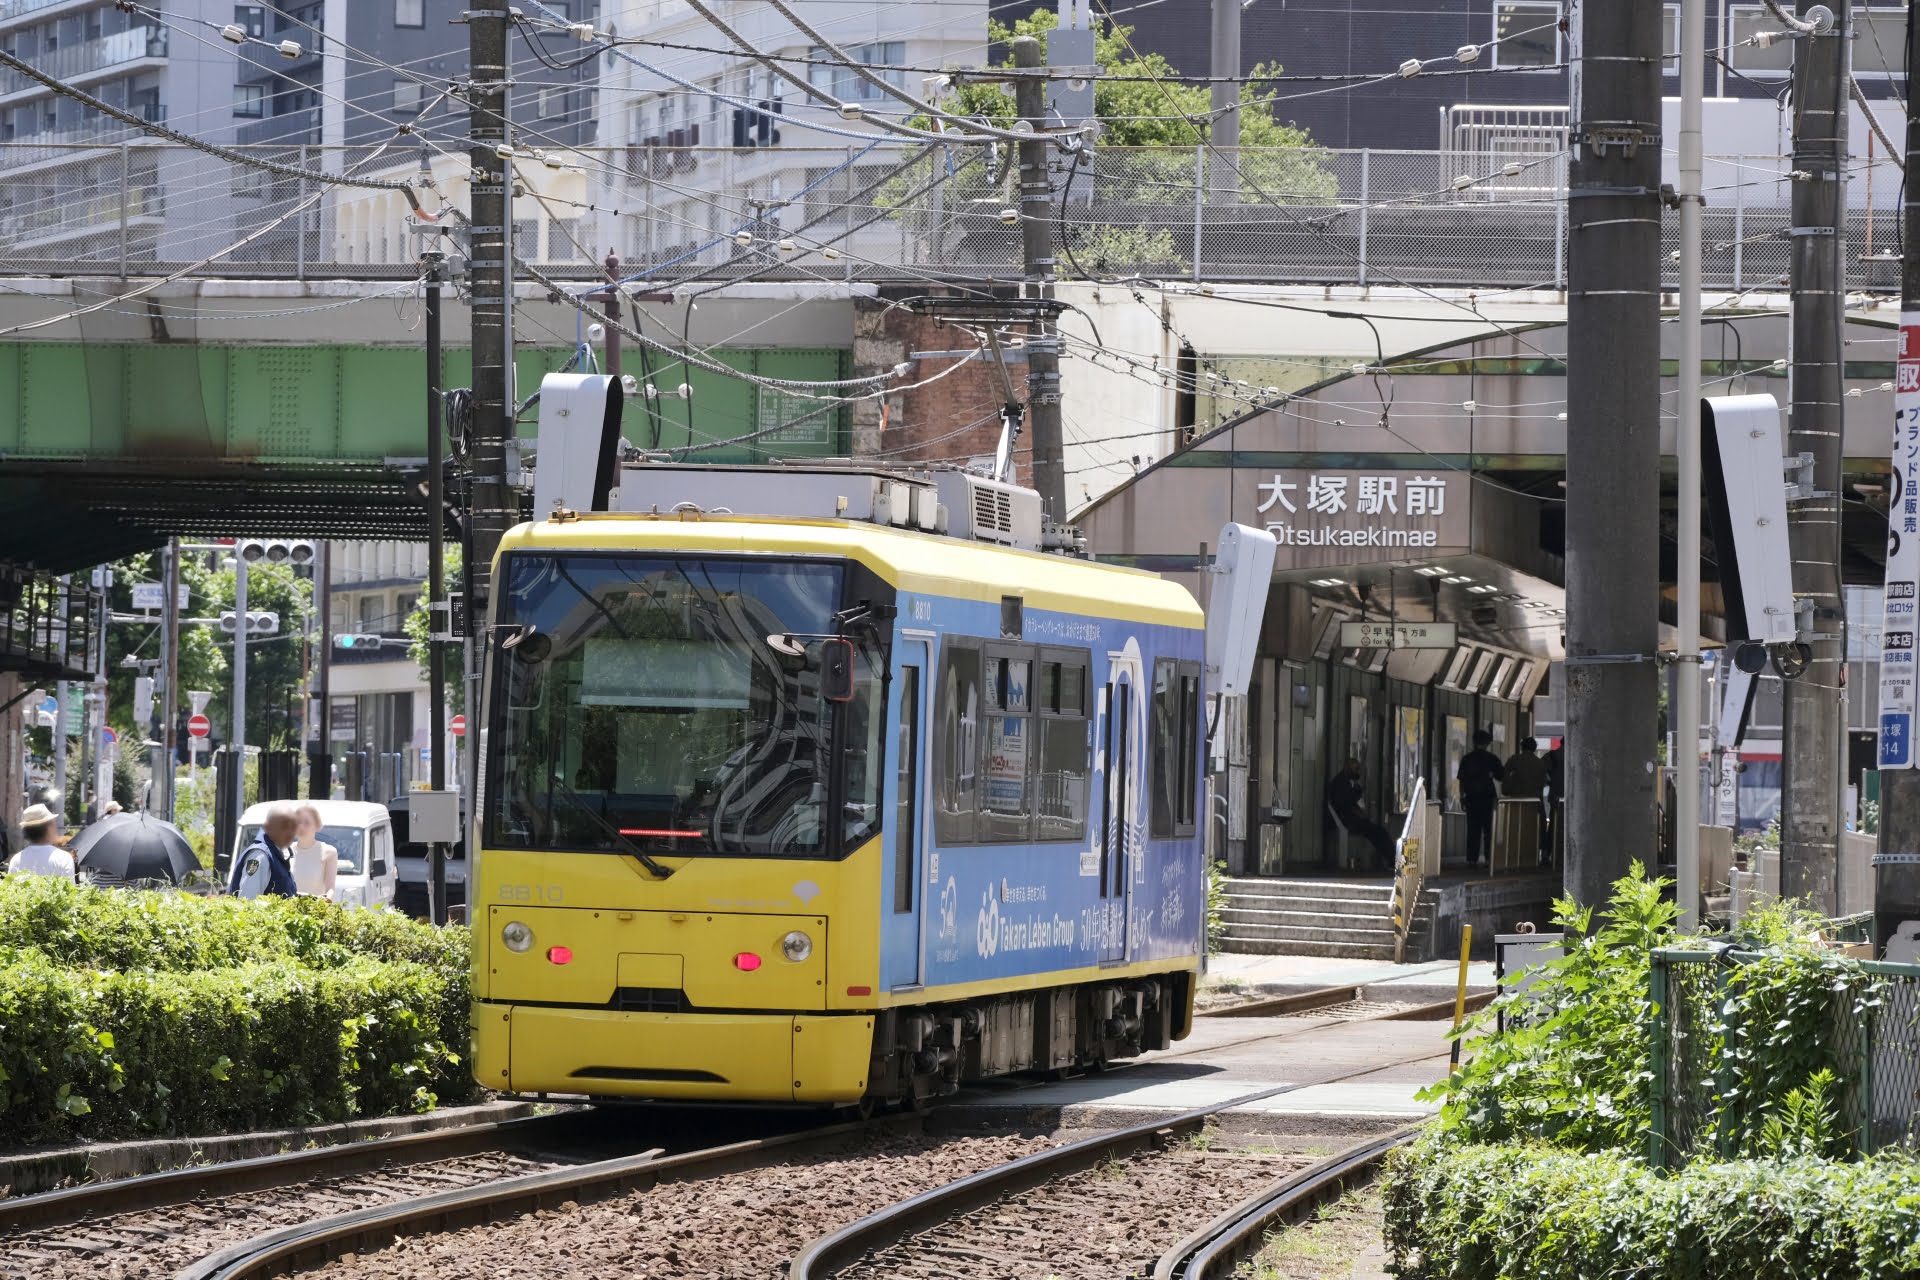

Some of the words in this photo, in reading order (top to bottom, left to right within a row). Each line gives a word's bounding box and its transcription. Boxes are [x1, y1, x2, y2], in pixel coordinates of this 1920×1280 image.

[1900, 364, 1920, 390] 取
[1904, 406, 1920, 534] ブランド品販売
[1257, 474, 1446, 516] 大塚駅前
[915, 600, 931, 621] 8810
[1880, 741, 1899, 756] -14
[1722, 768, 1731, 797] さのや
[499, 884, 563, 902] 8810
[1000, 917, 1027, 952] Takara
[1028, 915, 1050, 949] Leben
[1053, 912, 1075, 952] Group
